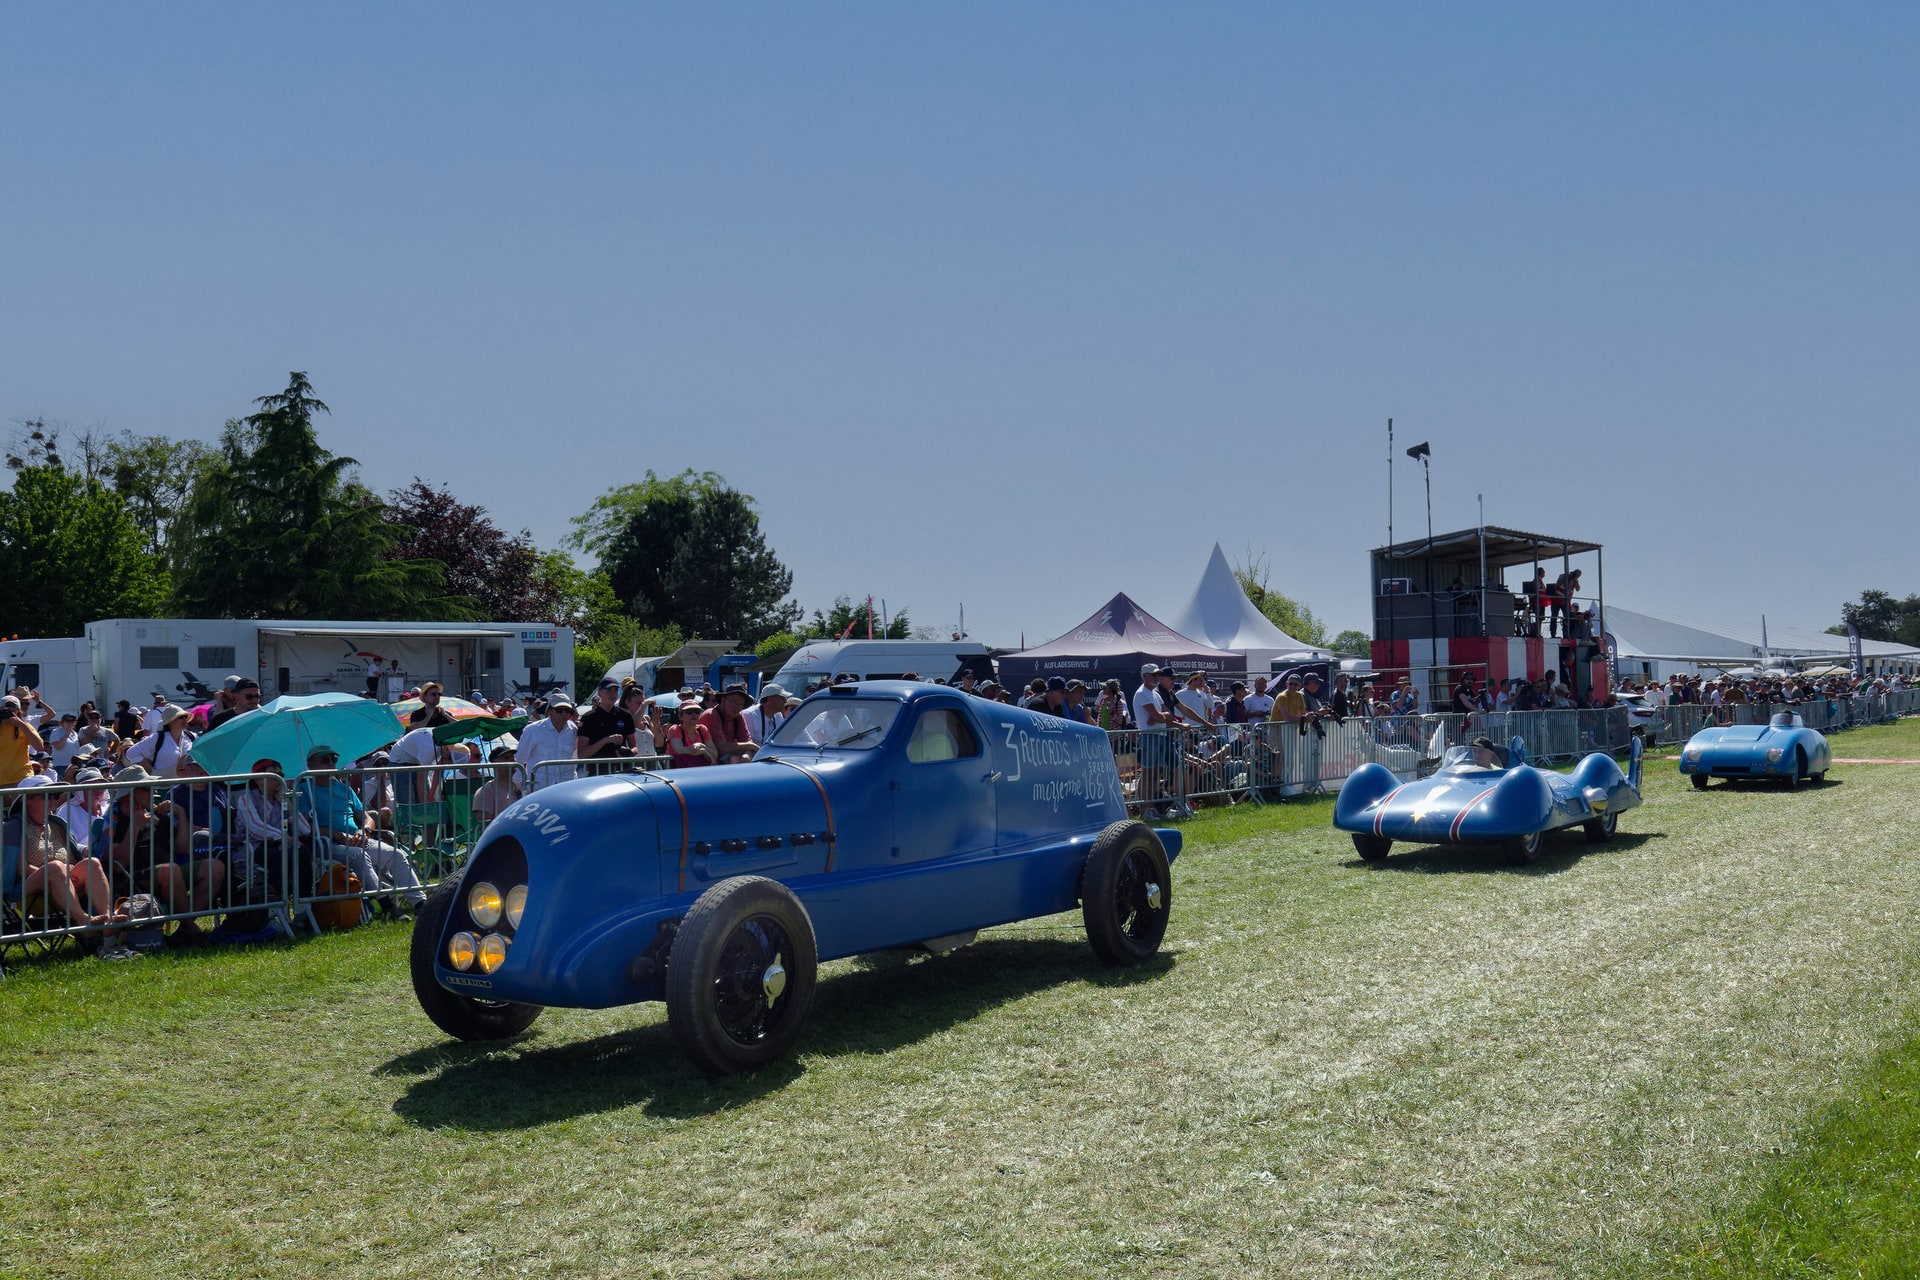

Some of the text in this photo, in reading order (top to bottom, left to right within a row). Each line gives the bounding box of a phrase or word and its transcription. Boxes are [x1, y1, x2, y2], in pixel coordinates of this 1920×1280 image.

[1044, 660, 1090, 669] AUFLADESERVICE
[1171, 660, 1219, 670] SERVICIO DE RECARGA
[1001, 722, 1020, 781] 3
[1020, 730, 1071, 767] RECORDS
